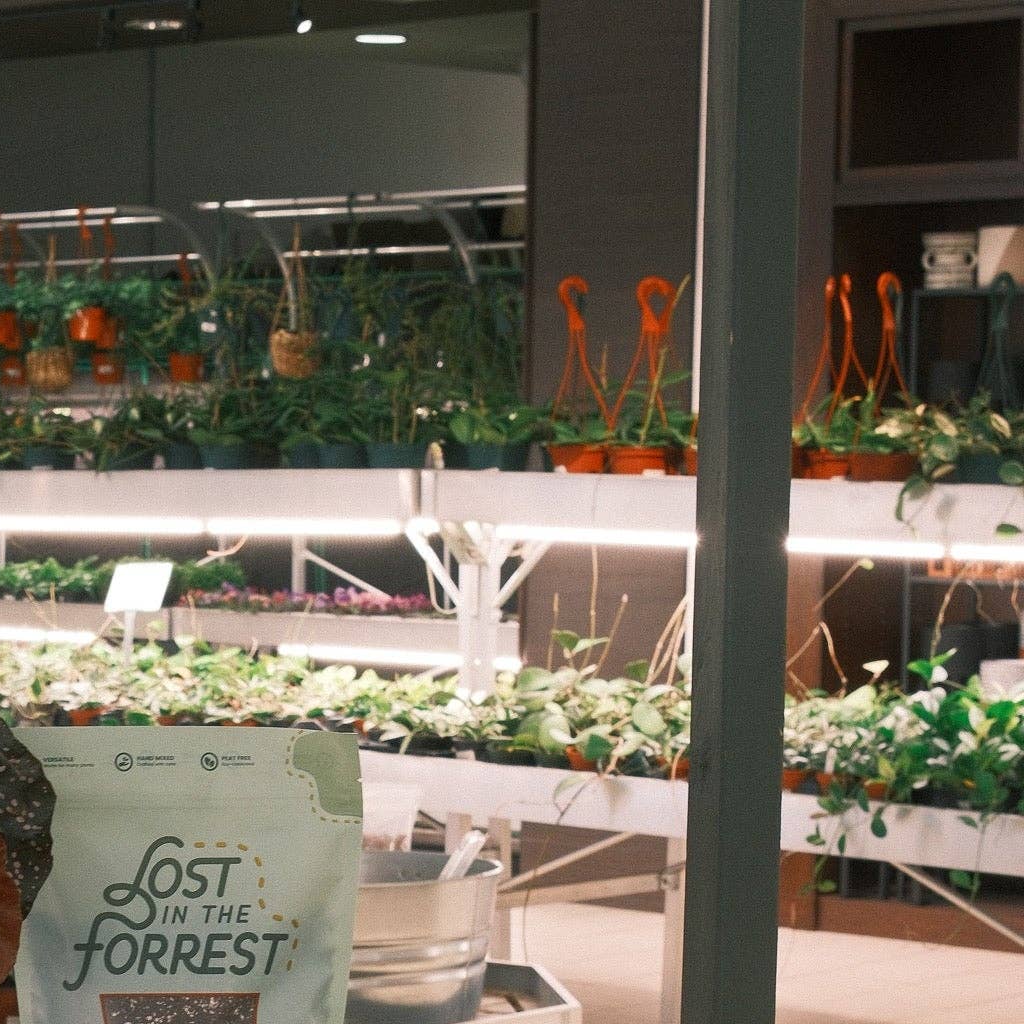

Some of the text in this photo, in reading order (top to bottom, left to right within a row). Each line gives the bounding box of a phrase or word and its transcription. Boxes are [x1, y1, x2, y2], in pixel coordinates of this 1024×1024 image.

[103, 836, 241, 908] LOST
[161, 904, 252, 925] IN THE
[63, 912, 289, 991] FORREST
